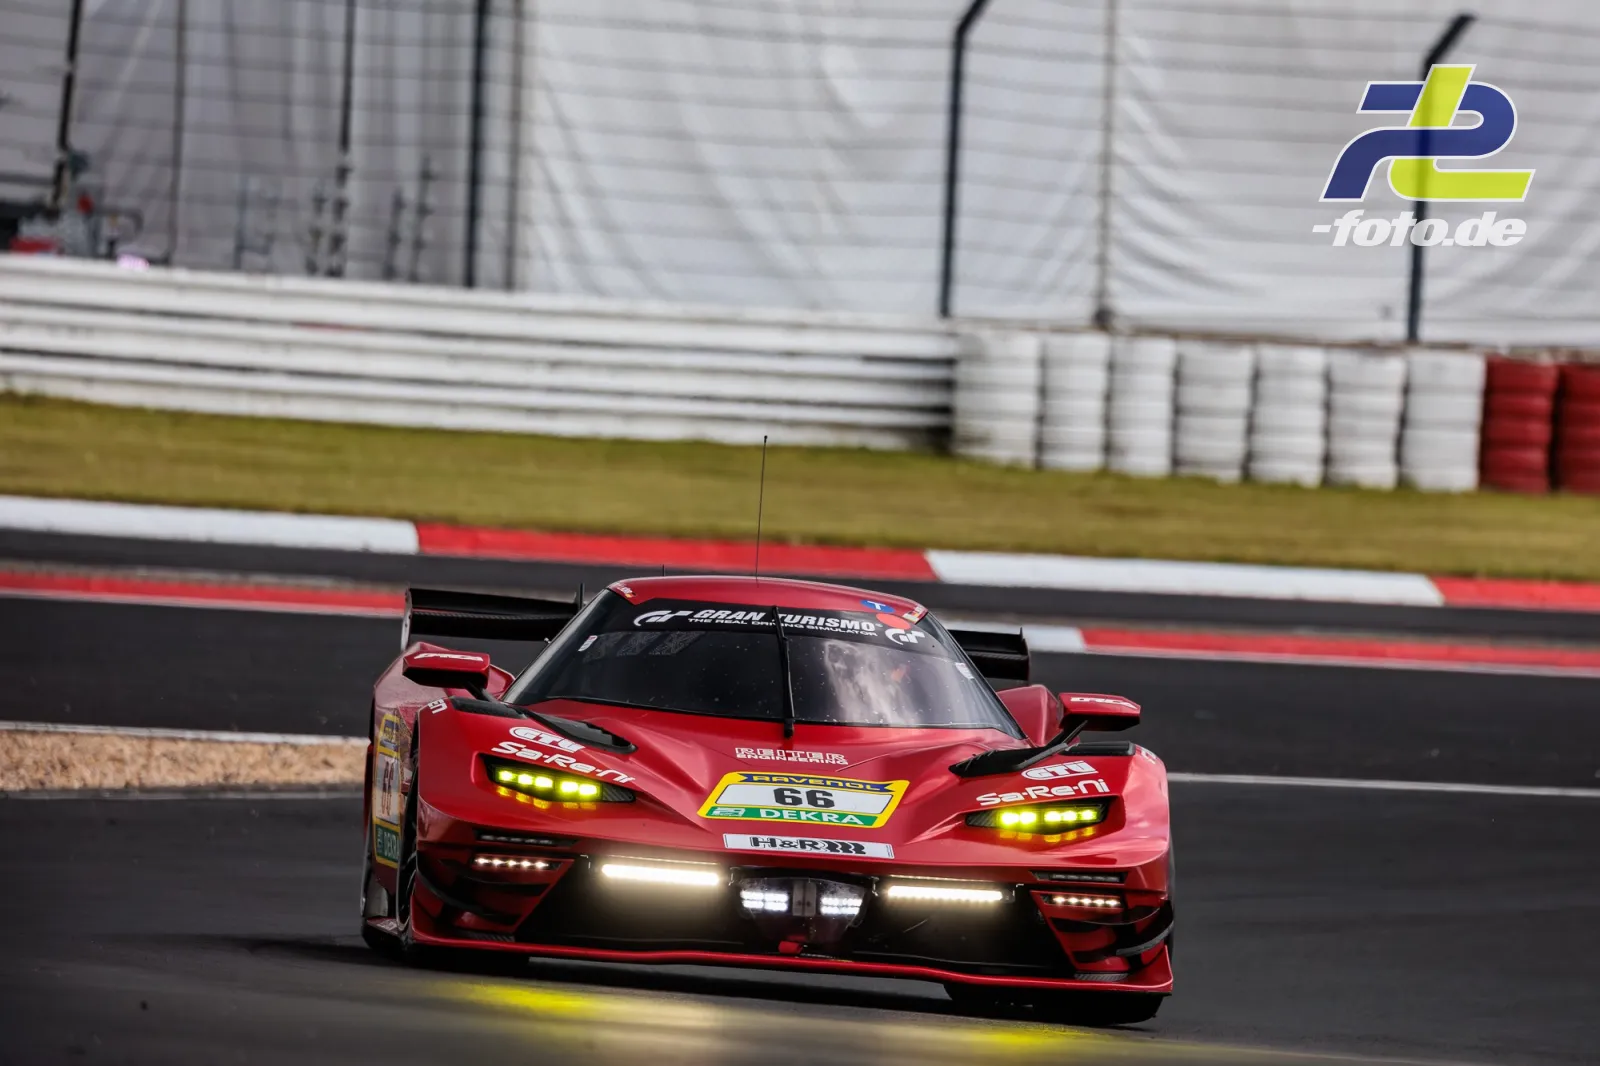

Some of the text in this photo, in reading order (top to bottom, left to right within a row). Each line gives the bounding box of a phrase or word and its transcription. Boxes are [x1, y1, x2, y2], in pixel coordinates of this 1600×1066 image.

[693, 609, 767, 621] GRAN
[751, 621, 804, 630] DRIING
[806, 625, 878, 637] SIMULATOR
[735, 747, 846, 761] REITER
[736, 753, 849, 765] ENGINEERING
[773, 787, 835, 809] 66
[759, 808, 865, 825] DEKRA
